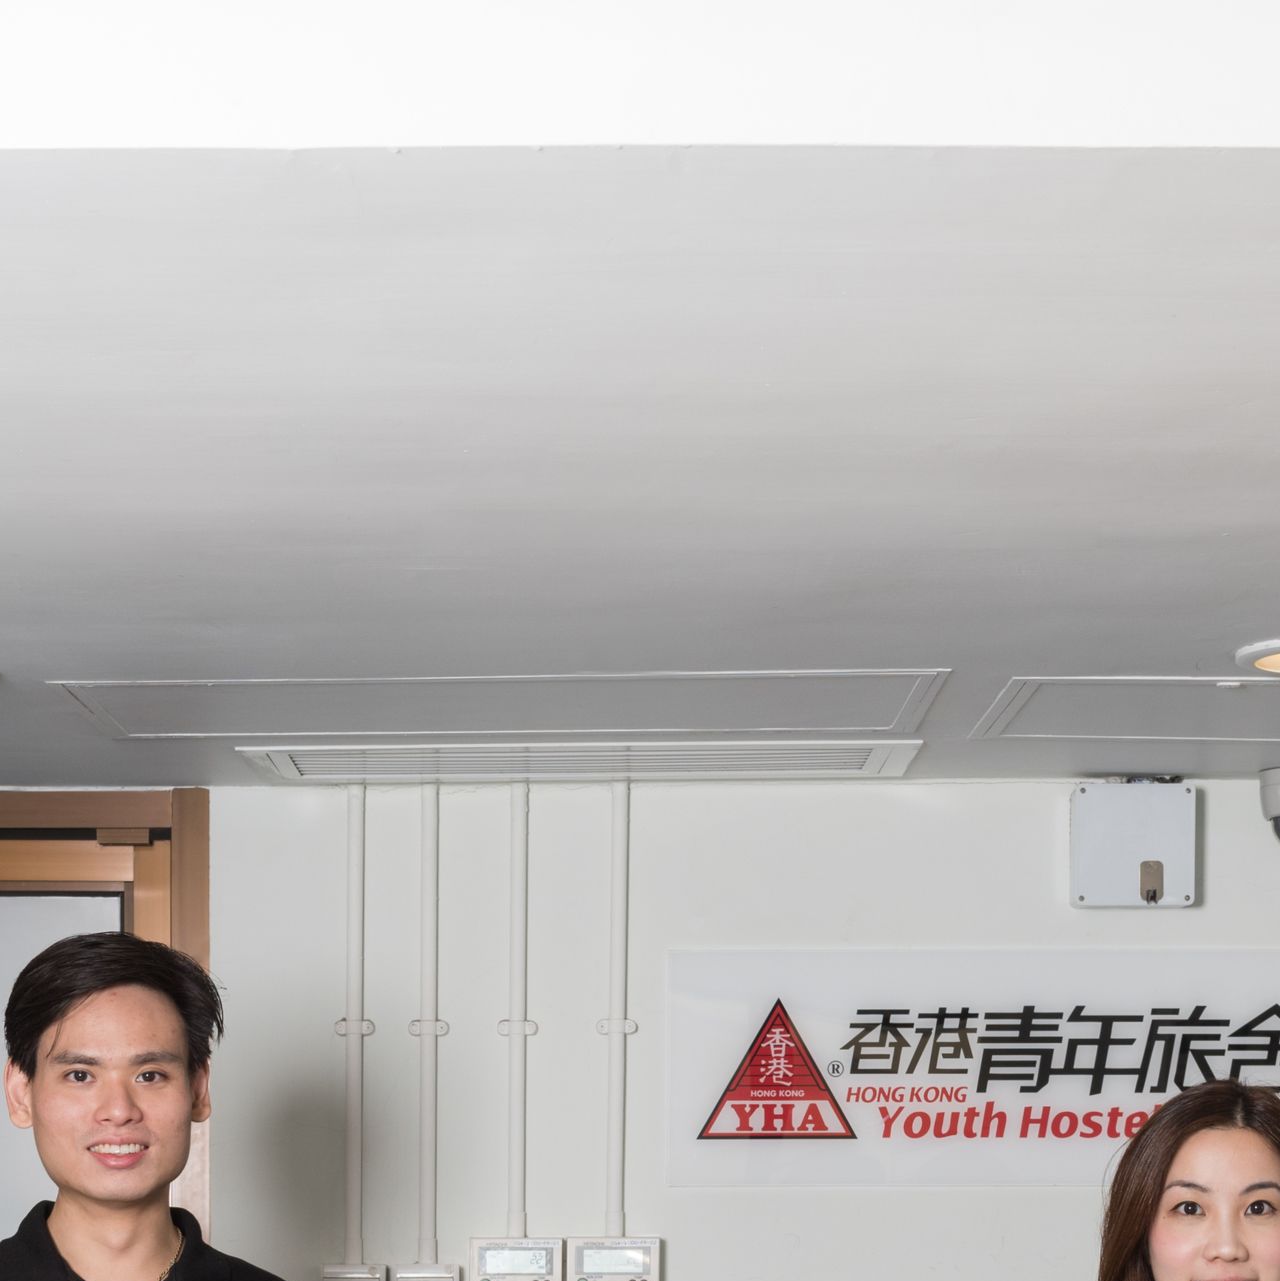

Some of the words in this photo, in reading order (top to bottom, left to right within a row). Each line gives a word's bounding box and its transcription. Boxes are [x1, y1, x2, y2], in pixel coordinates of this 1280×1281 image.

[760, 1028, 795, 1087] 香港
[750, 1089, 777, 1098] HONG
[779, 1089, 805, 1098] KONG
[846, 1086, 906, 1103] HONG
[909, 1086, 968, 1103] KONG
[731, 1103, 829, 1132] YHA
[878, 1101, 1008, 1138] Youth
[1019, 1104, 1163, 1139] Hoste
